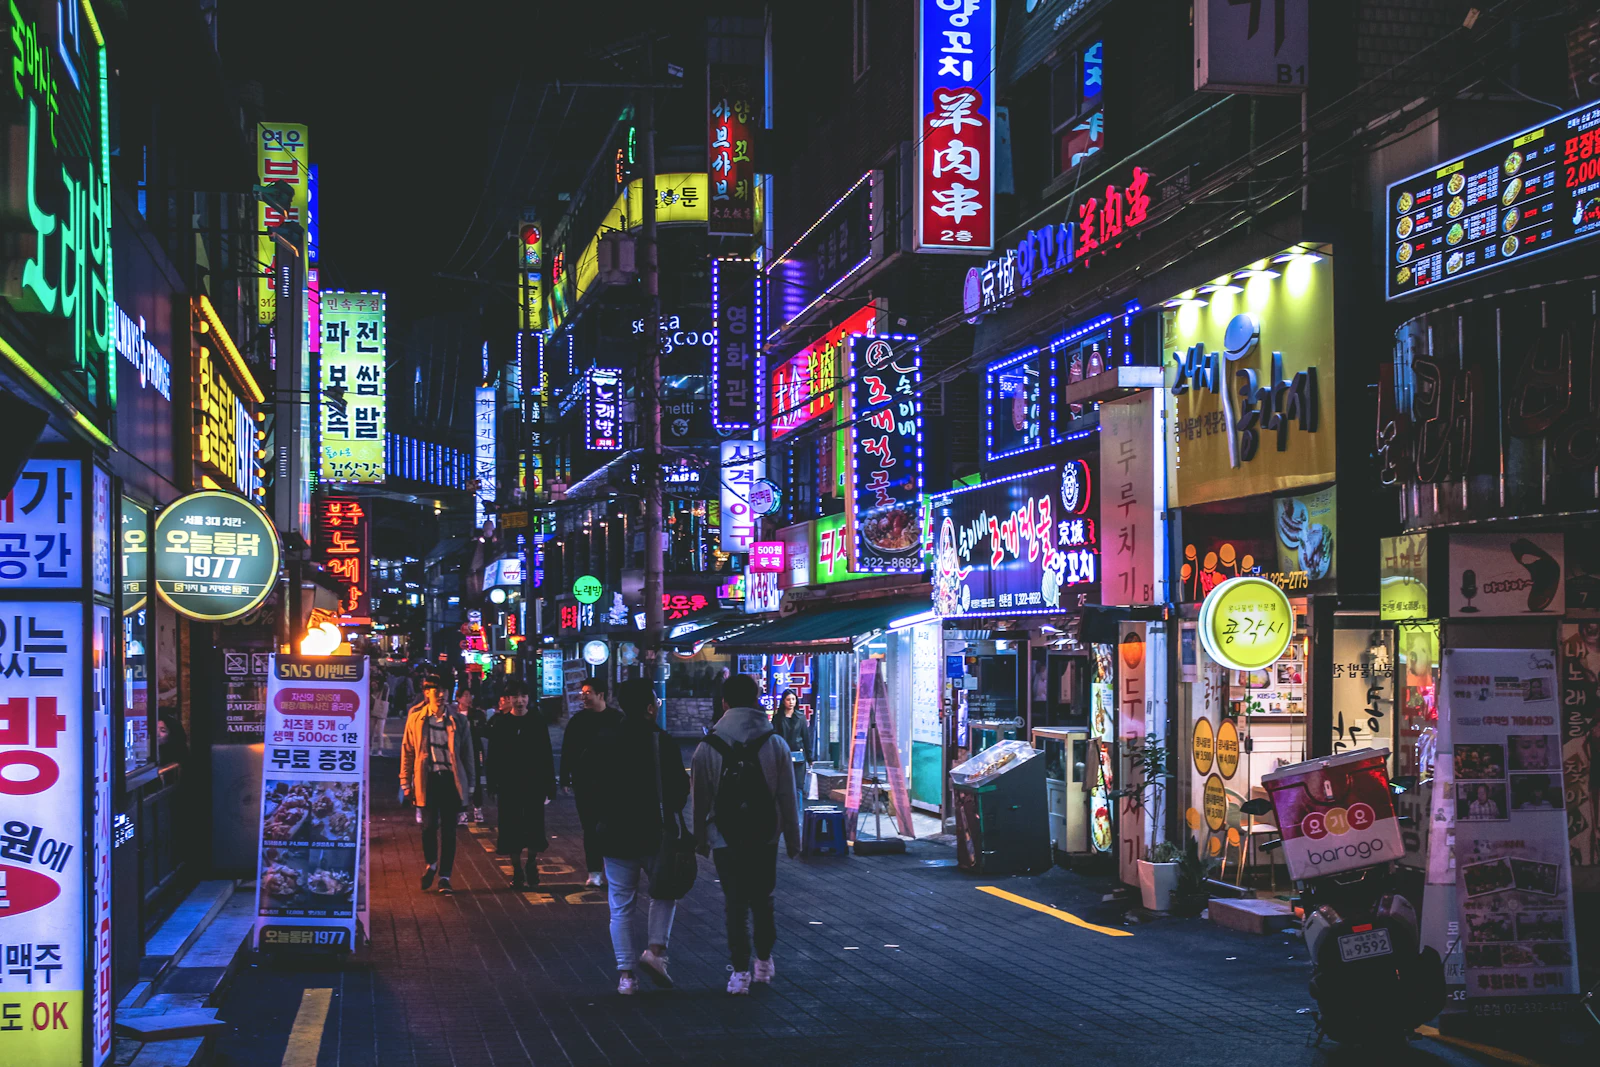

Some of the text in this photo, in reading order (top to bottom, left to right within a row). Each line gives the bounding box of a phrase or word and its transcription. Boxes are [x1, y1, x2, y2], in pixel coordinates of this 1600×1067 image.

[1277, 63, 1305, 84] B1
[261, 129, 304, 152] 연우
[929, 93, 983, 224] 羊肉串
[940, 230, 973, 242] 2층
[327, 298, 379, 310] 민속주점
[326, 321, 380, 353] 파전
[329, 366, 380, 395] 보쌈
[594, 386, 616, 437] 노래방
[330, 463, 380, 477] 김삿갓
[205, 516, 220, 526] 3대
[222, 517, 242, 527] 치킨
[1117, 440, 1137, 599] 두루치기
[166, 530, 261, 556] 오늘통닭
[1058, 520, 1084, 545] 京城
[758, 545, 782, 555] 500원
[184, 555, 242, 578] 1977
[760, 559, 781, 568] 두곡
[864, 557, 918, 567] 322-8682
[1051, 549, 1094, 586] 양꼬치
[574, 585, 601, 597] 노래방
[1143, 584, 1154, 601] B1
[1222, 617, 1284, 644] 콩각시
[280, 663, 358, 680] SNS 이벤트
[282, 719, 349, 731] 치즈볼 5개 or
[272, 731, 358, 744] 생맥 500cc 1잔
[271, 749, 356, 771] 무료 증정
[1308, 808, 1369, 835] 요기요
[1307, 838, 1384, 864] barogo
[265, 930, 346, 944] 오늘통닭 1977
[1354, 939, 1388, 956] 9592
[33, 1002, 69, 1031] OK
